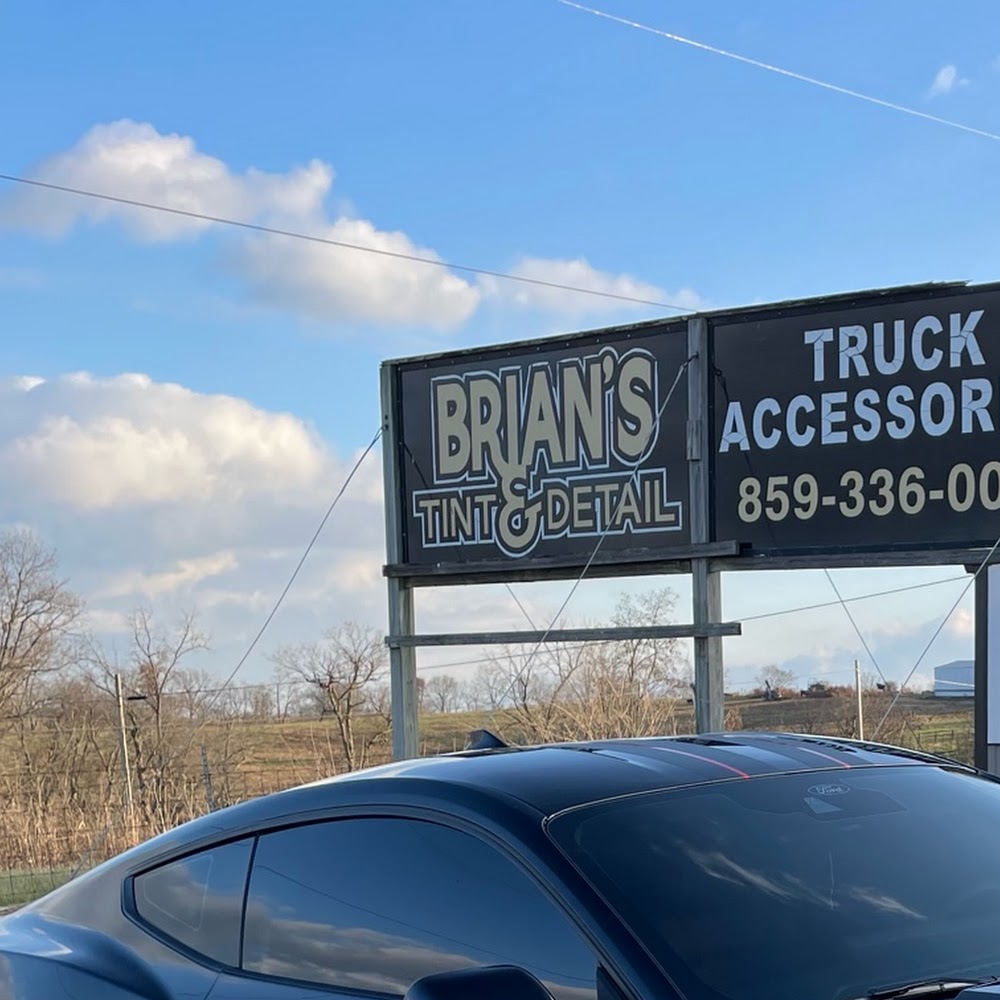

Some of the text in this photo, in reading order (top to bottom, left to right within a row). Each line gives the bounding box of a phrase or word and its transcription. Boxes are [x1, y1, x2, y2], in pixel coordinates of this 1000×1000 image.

[804, 310, 986, 381] TRUCK
[436, 354, 654, 475] BRIAN'S
[418, 465, 676, 549] TINT & DETAIL
